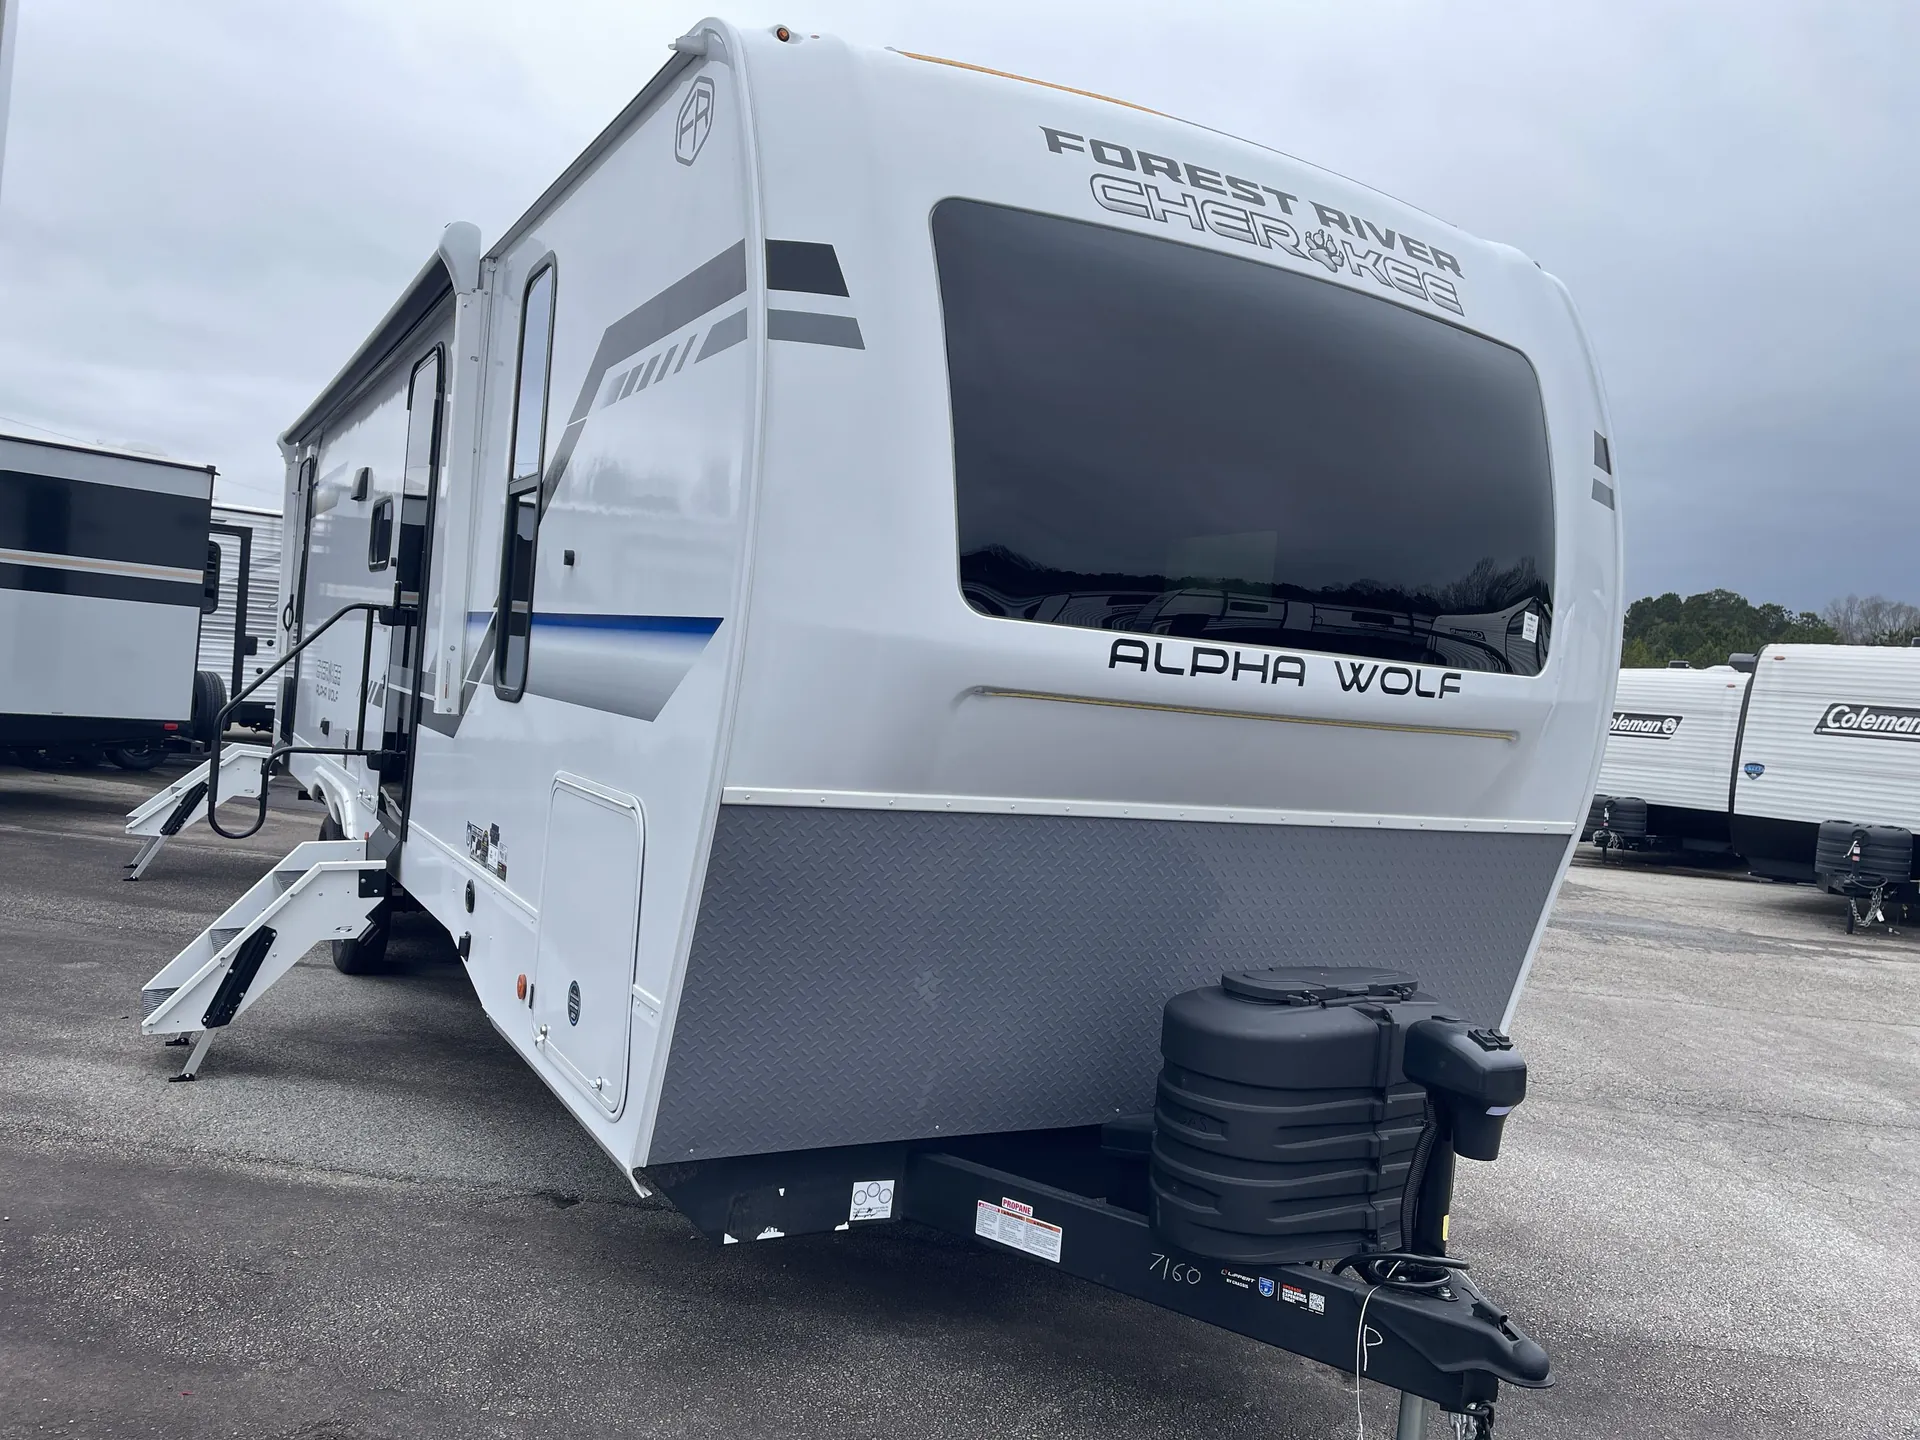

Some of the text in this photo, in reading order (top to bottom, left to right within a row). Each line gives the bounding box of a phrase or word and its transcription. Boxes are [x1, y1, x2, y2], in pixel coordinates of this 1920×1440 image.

[1039, 125, 1465, 279] FOREST RIVER
[1108, 638, 1461, 699] ALPHA WOLF
[1610, 713, 1662, 733] oleman
[1002, 1199, 1032, 1215] PROPANE
[1148, 1252, 1202, 1285] 7160
[1227, 1270, 1256, 1283] LIPPERT
[1362, 1323, 1384, 1372] P
